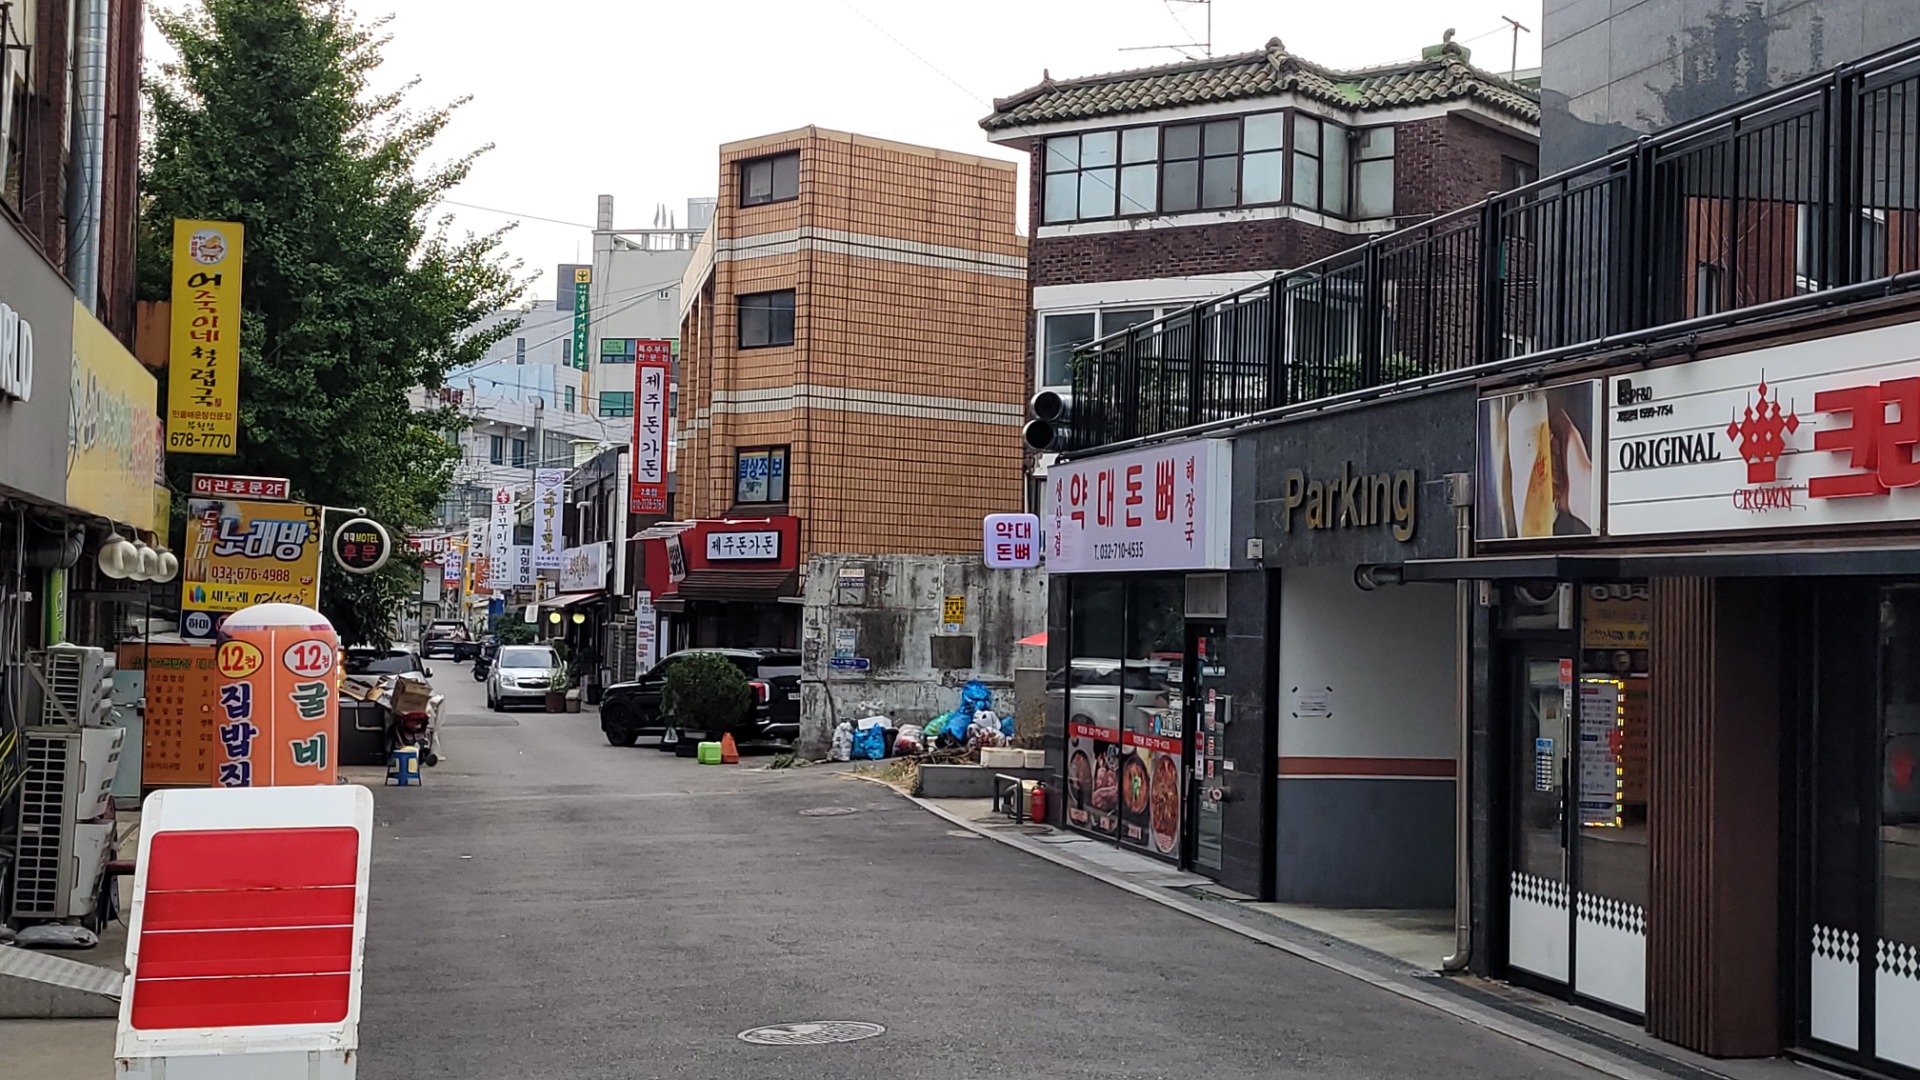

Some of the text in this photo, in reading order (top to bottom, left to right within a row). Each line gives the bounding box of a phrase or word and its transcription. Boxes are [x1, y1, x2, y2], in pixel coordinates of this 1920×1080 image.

[187, 272, 222, 342] 어죽이네
[0, 303, 33, 402] RLD
[170, 432, 231, 449] 678-7770
[641, 372, 661, 478] 제주돈가돈
[1619, 432, 1721, 470] ORIGINAL
[198, 478, 283, 495] 여관후문 2F
[1070, 457, 1176, 531] 약대돈뼈
[1184, 455, 1195, 550] 해장국
[1284, 460, 1417, 542] Parking
[1732, 486, 1793, 511] CROWN
[193, 509, 219, 560] 도레미
[213, 518, 309, 561] 노래방
[355, 532, 379, 544] MOTEL
[711, 535, 774, 556] 제주돈가돈
[995, 522, 1031, 541] 약대
[343, 543, 377, 562] 후문
[996, 543, 1030, 562] 돈뼈
[221, 645, 256, 672] 12첩
[293, 644, 329, 672] 12첩
[219, 682, 259, 787] 집밥집
[290, 681, 328, 770] 굴비
